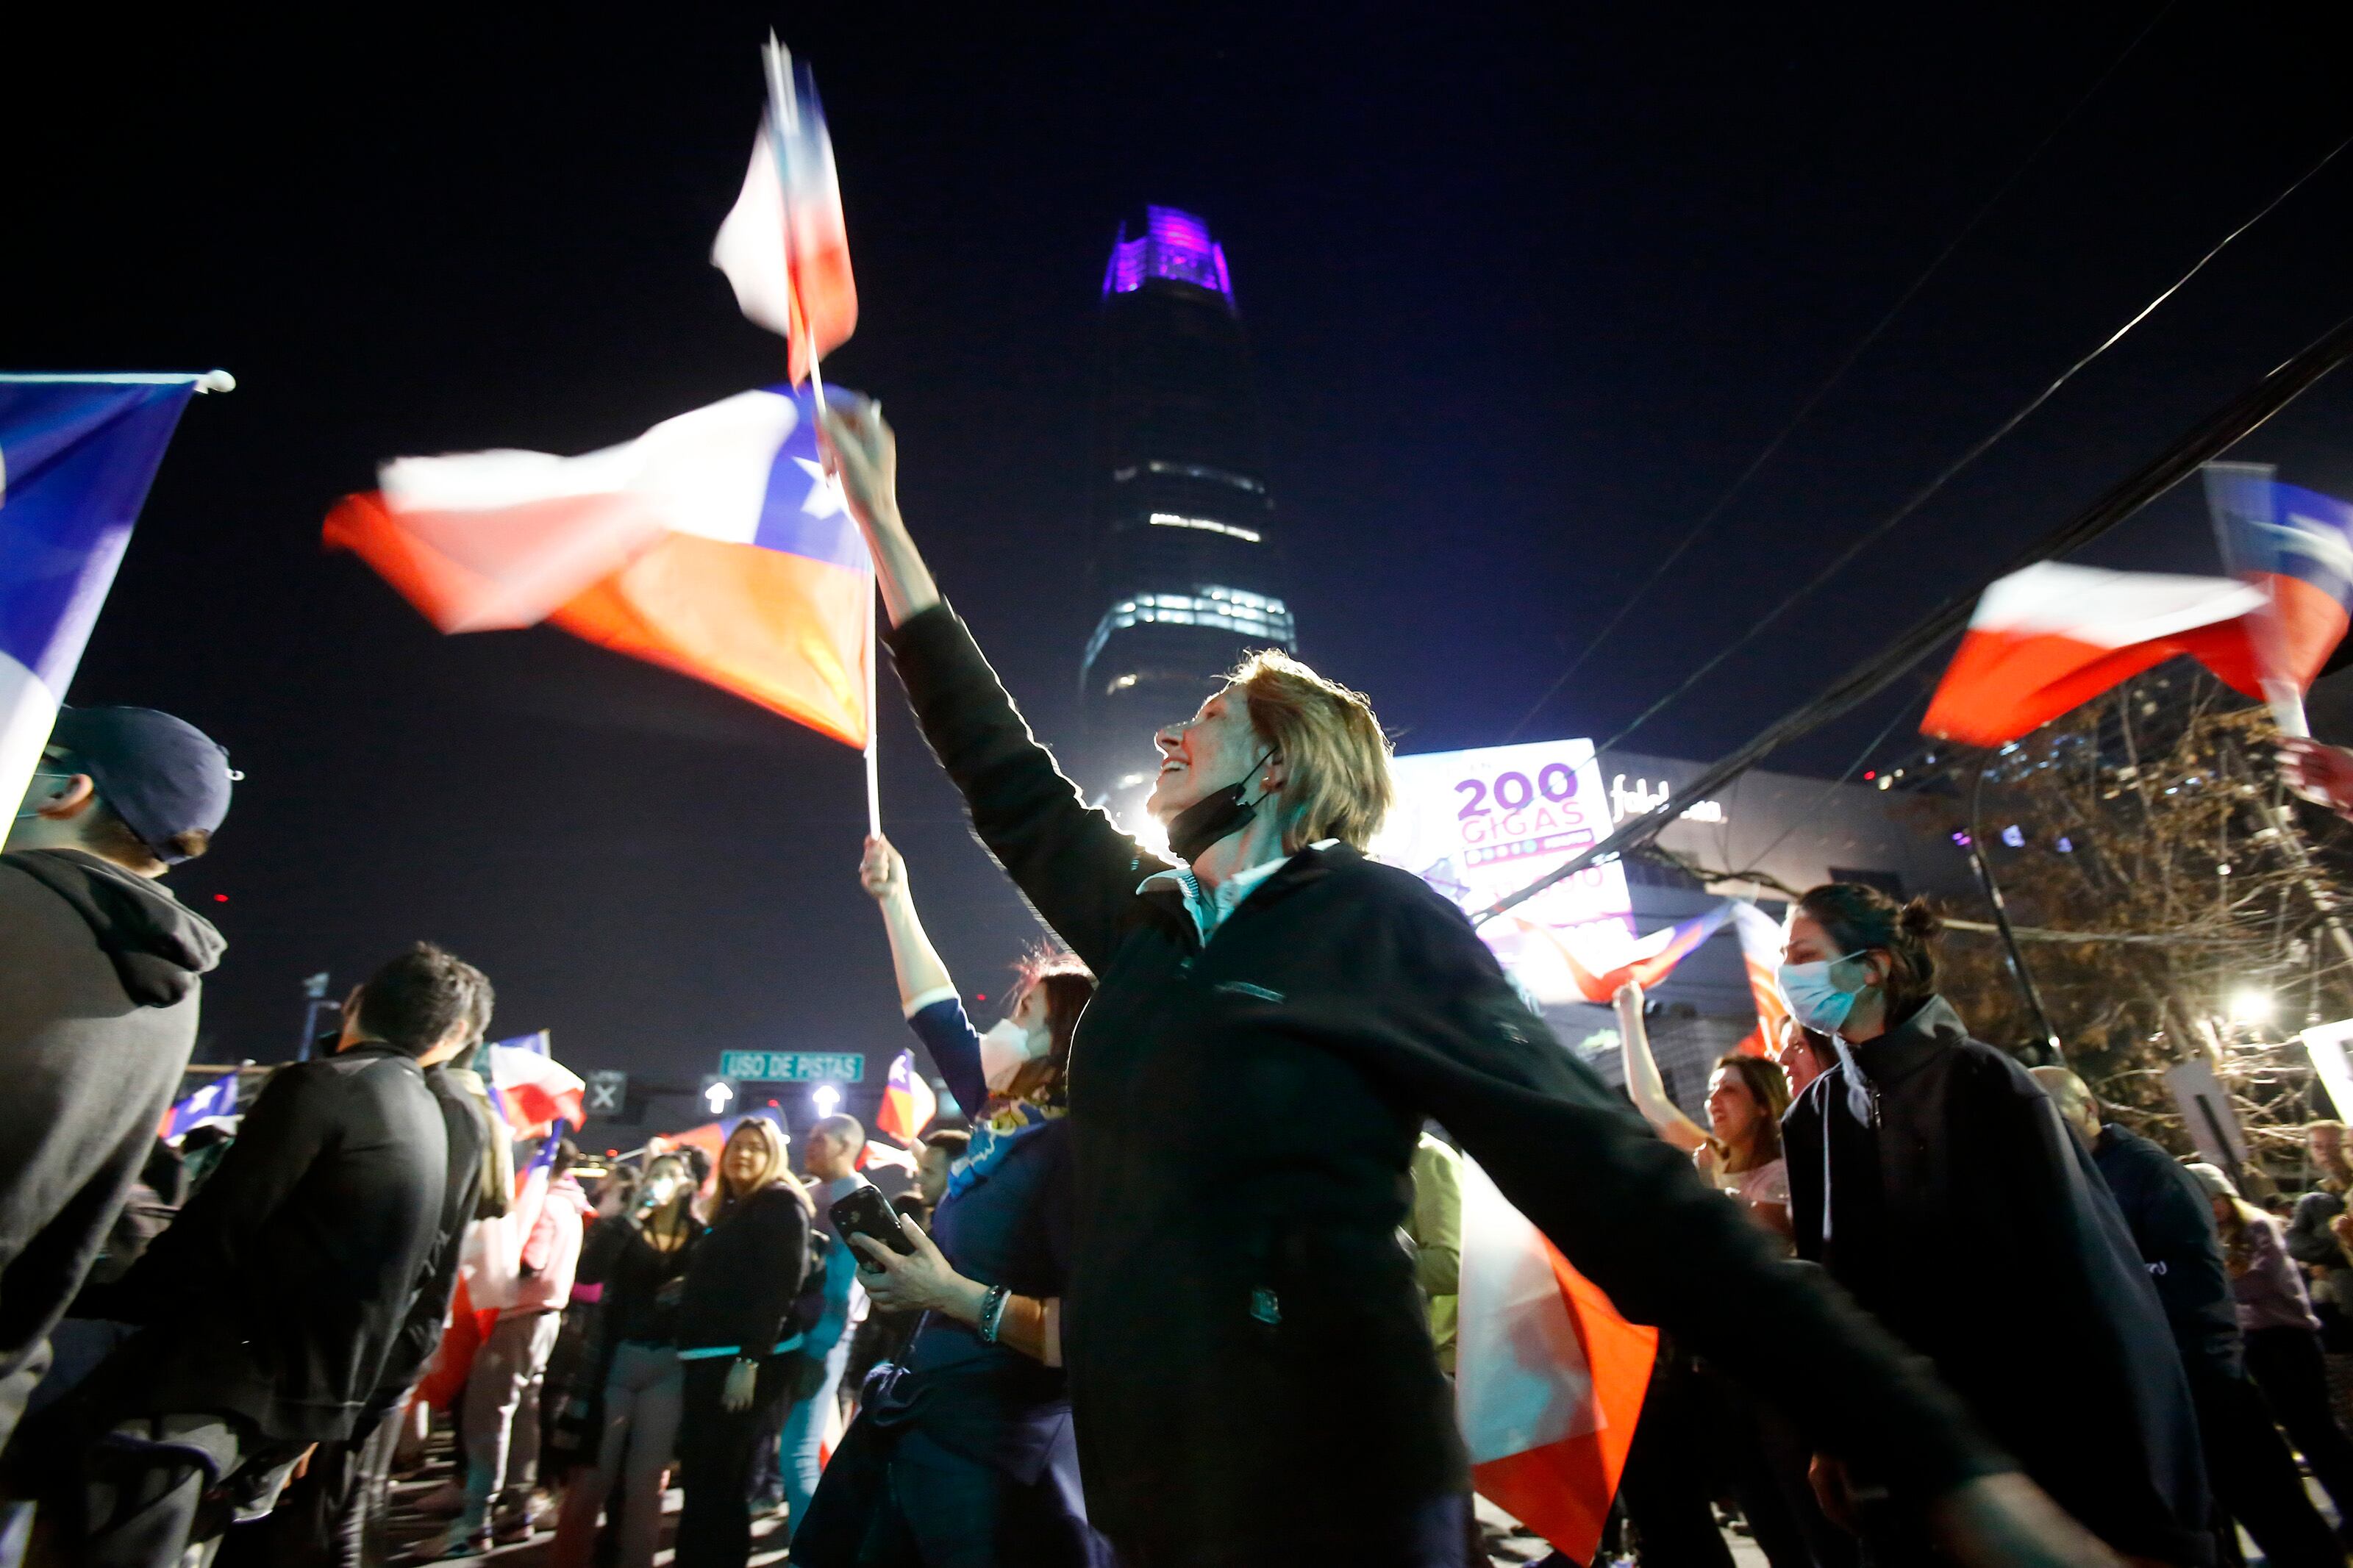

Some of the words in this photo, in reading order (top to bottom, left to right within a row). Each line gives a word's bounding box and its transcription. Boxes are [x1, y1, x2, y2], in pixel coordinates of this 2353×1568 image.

[1454, 762, 1579, 821] 200
[1462, 799, 1585, 844] GIGAS
[729, 1055, 765, 1077] USO
[769, 1055, 793, 1078] DE
[797, 1056, 855, 1079] PISTAS
